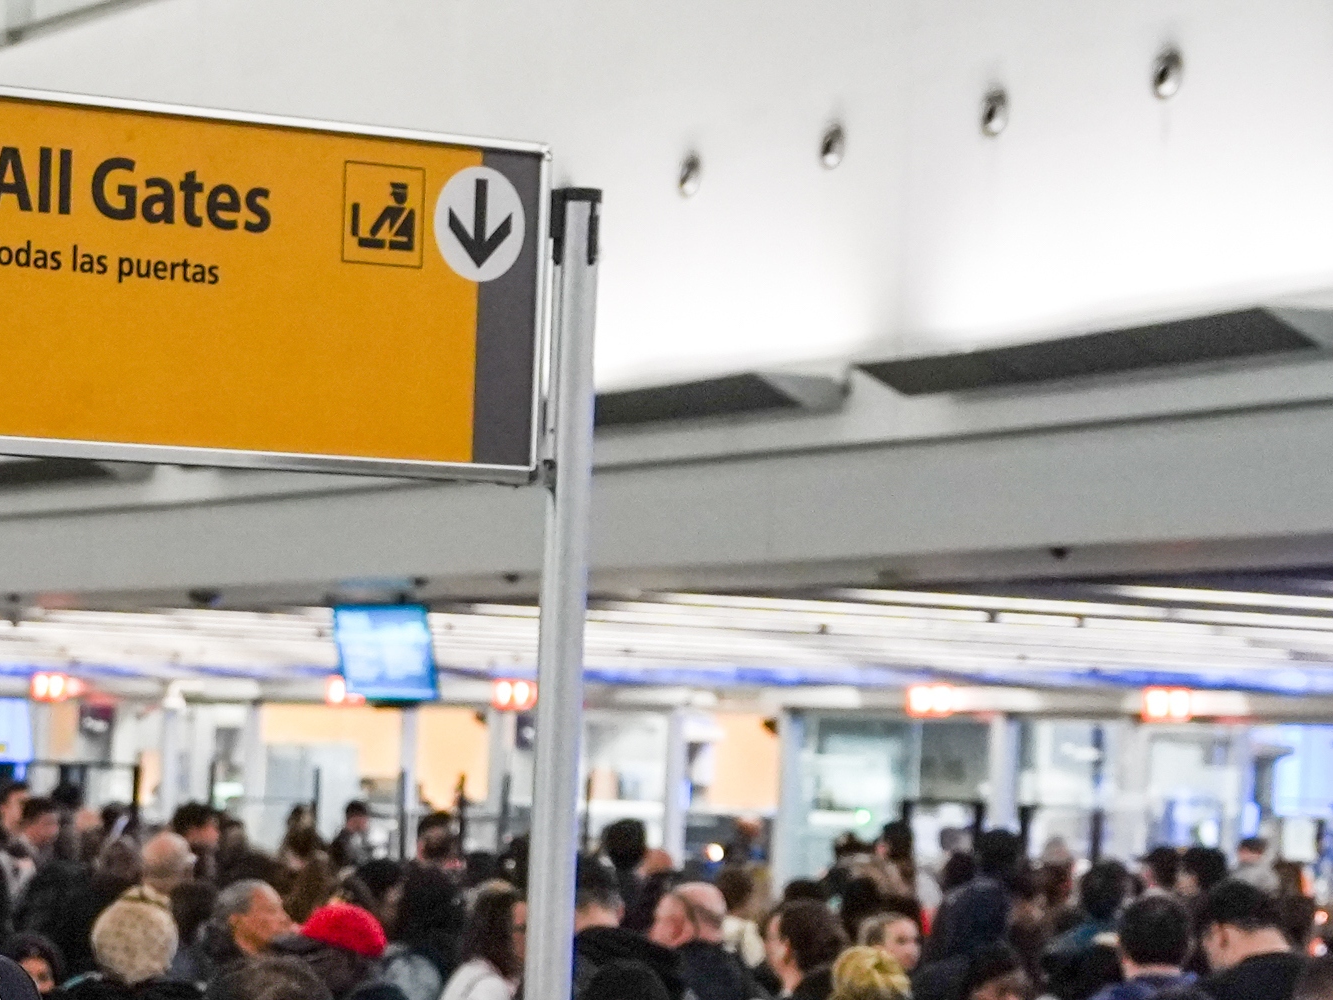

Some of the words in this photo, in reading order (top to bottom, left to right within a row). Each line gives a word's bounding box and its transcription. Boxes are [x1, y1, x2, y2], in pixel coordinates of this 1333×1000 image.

[91, 156, 272, 234] Gates
[71, 244, 108, 275] las
[117, 254, 220, 285] puertas
